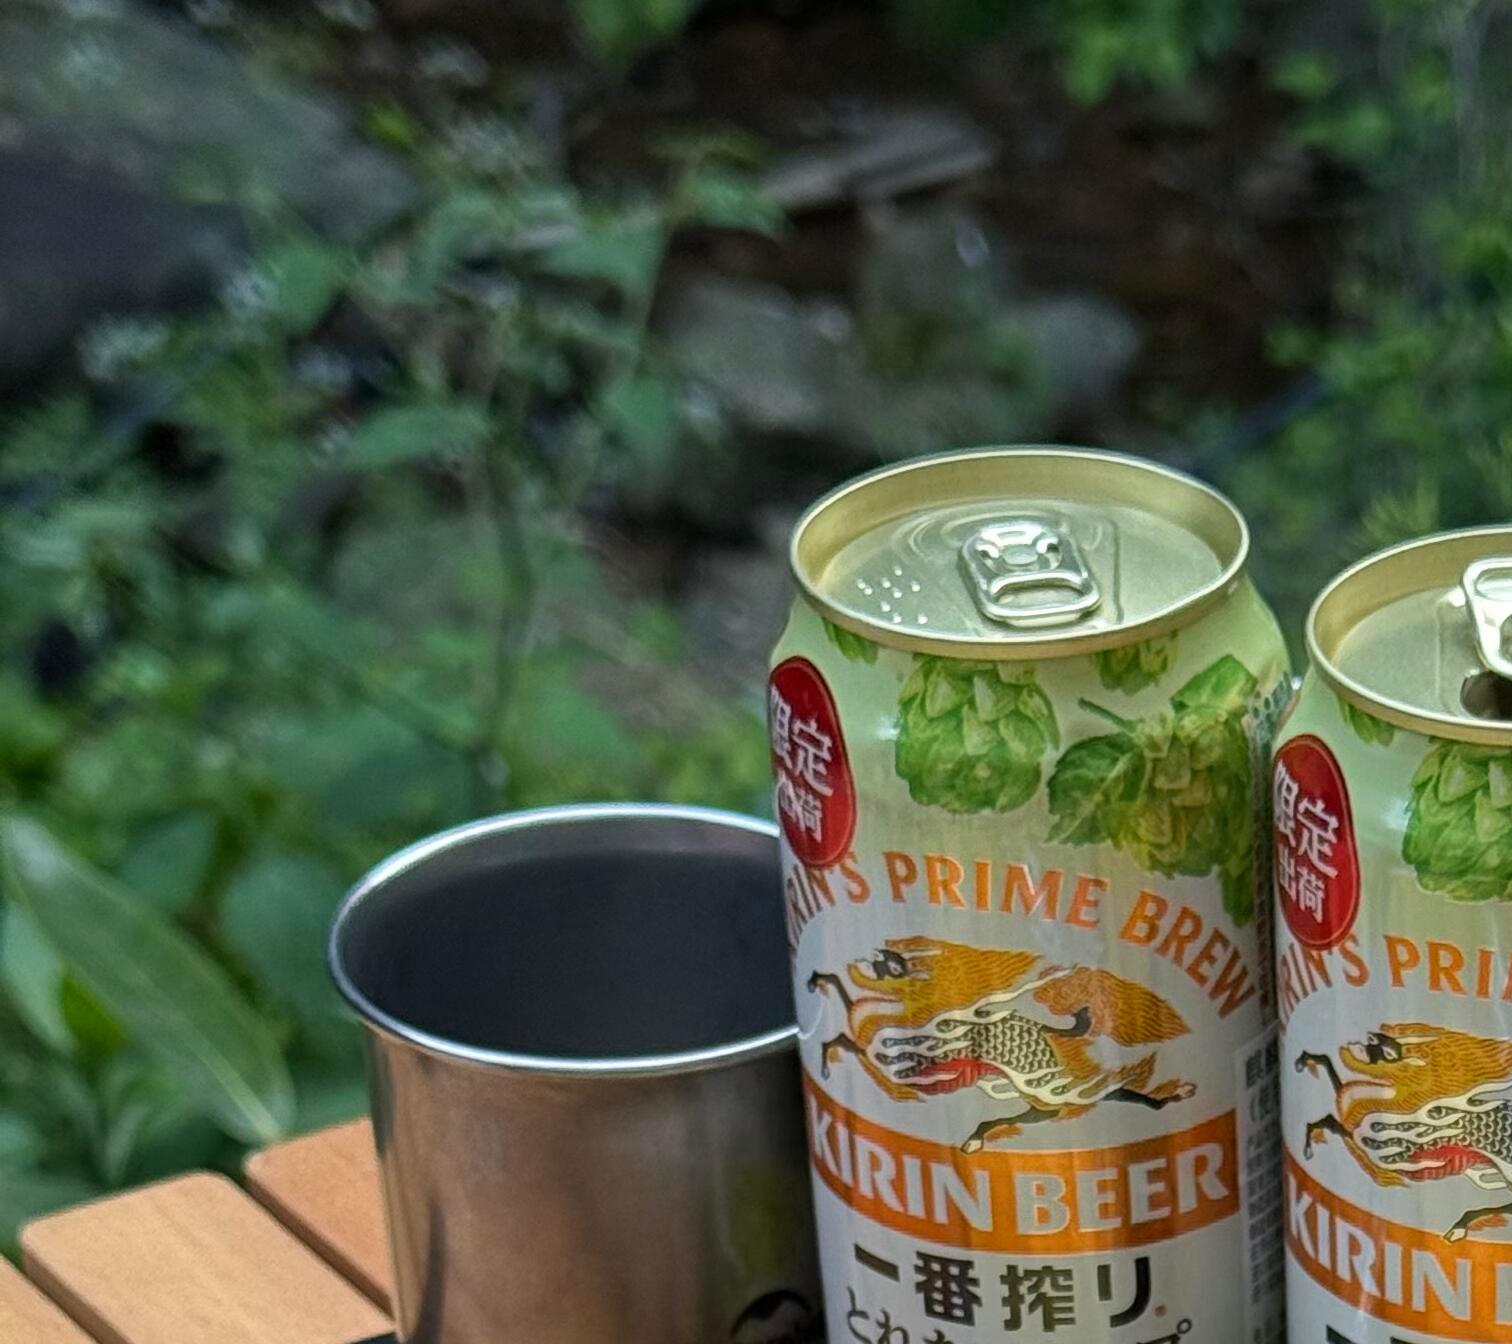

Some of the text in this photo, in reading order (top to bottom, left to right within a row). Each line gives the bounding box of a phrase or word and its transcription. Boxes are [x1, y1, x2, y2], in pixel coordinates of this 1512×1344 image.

[883, 851, 1107, 928] PRIME
[1120, 889, 1257, 1019] BREW
[811, 1098, 993, 1232] KIRIN
[1015, 1142, 1229, 1234] BEER
[1287, 1171, 1472, 1321] KIRIN
